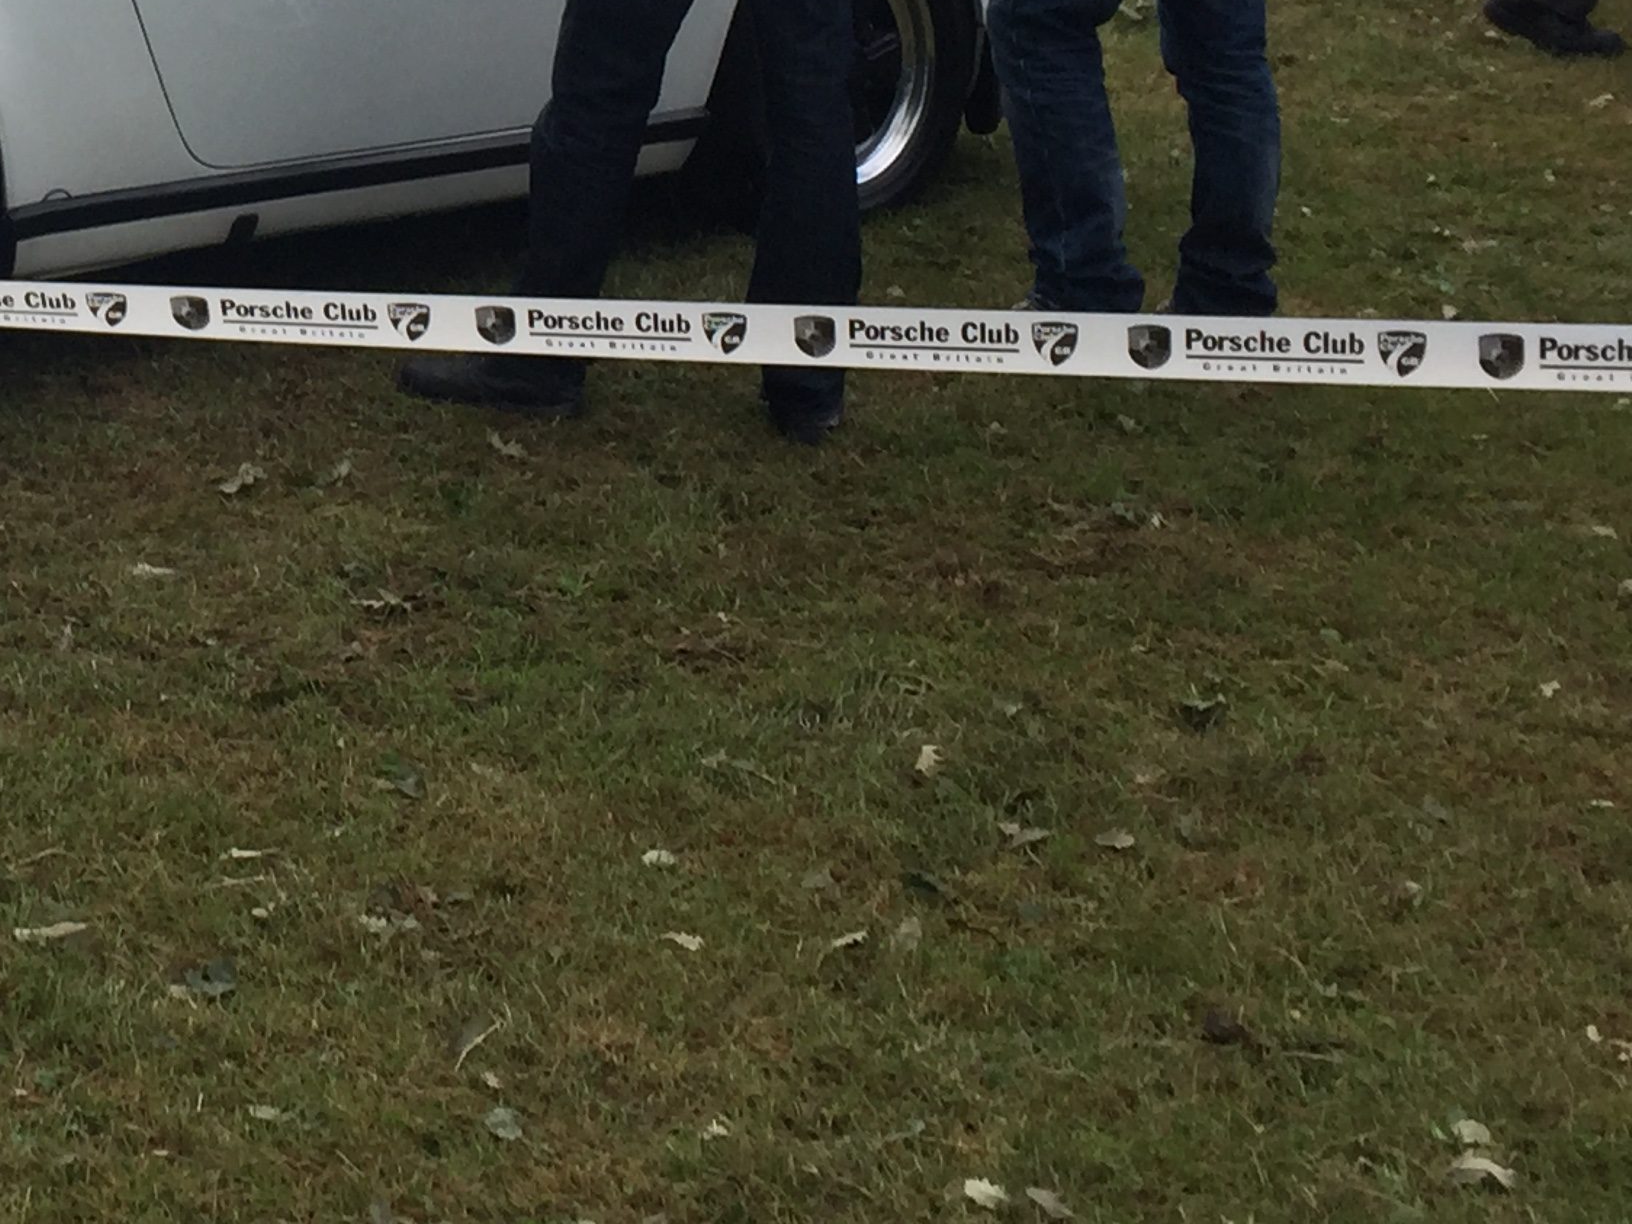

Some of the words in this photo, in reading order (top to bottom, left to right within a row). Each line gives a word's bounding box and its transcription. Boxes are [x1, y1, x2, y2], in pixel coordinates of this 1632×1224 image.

[24, 291, 77, 309] Club
[220, 298, 313, 320] Porsche
[323, 302, 377, 322] Club
[528, 309, 624, 332] Porsche
[635, 313, 691, 334] Club
[848, 319, 950, 343] Porsche
[961, 322, 1019, 345] Club
[1186, 329, 1291, 353] Porsche
[1304, 331, 1365, 355] Club
